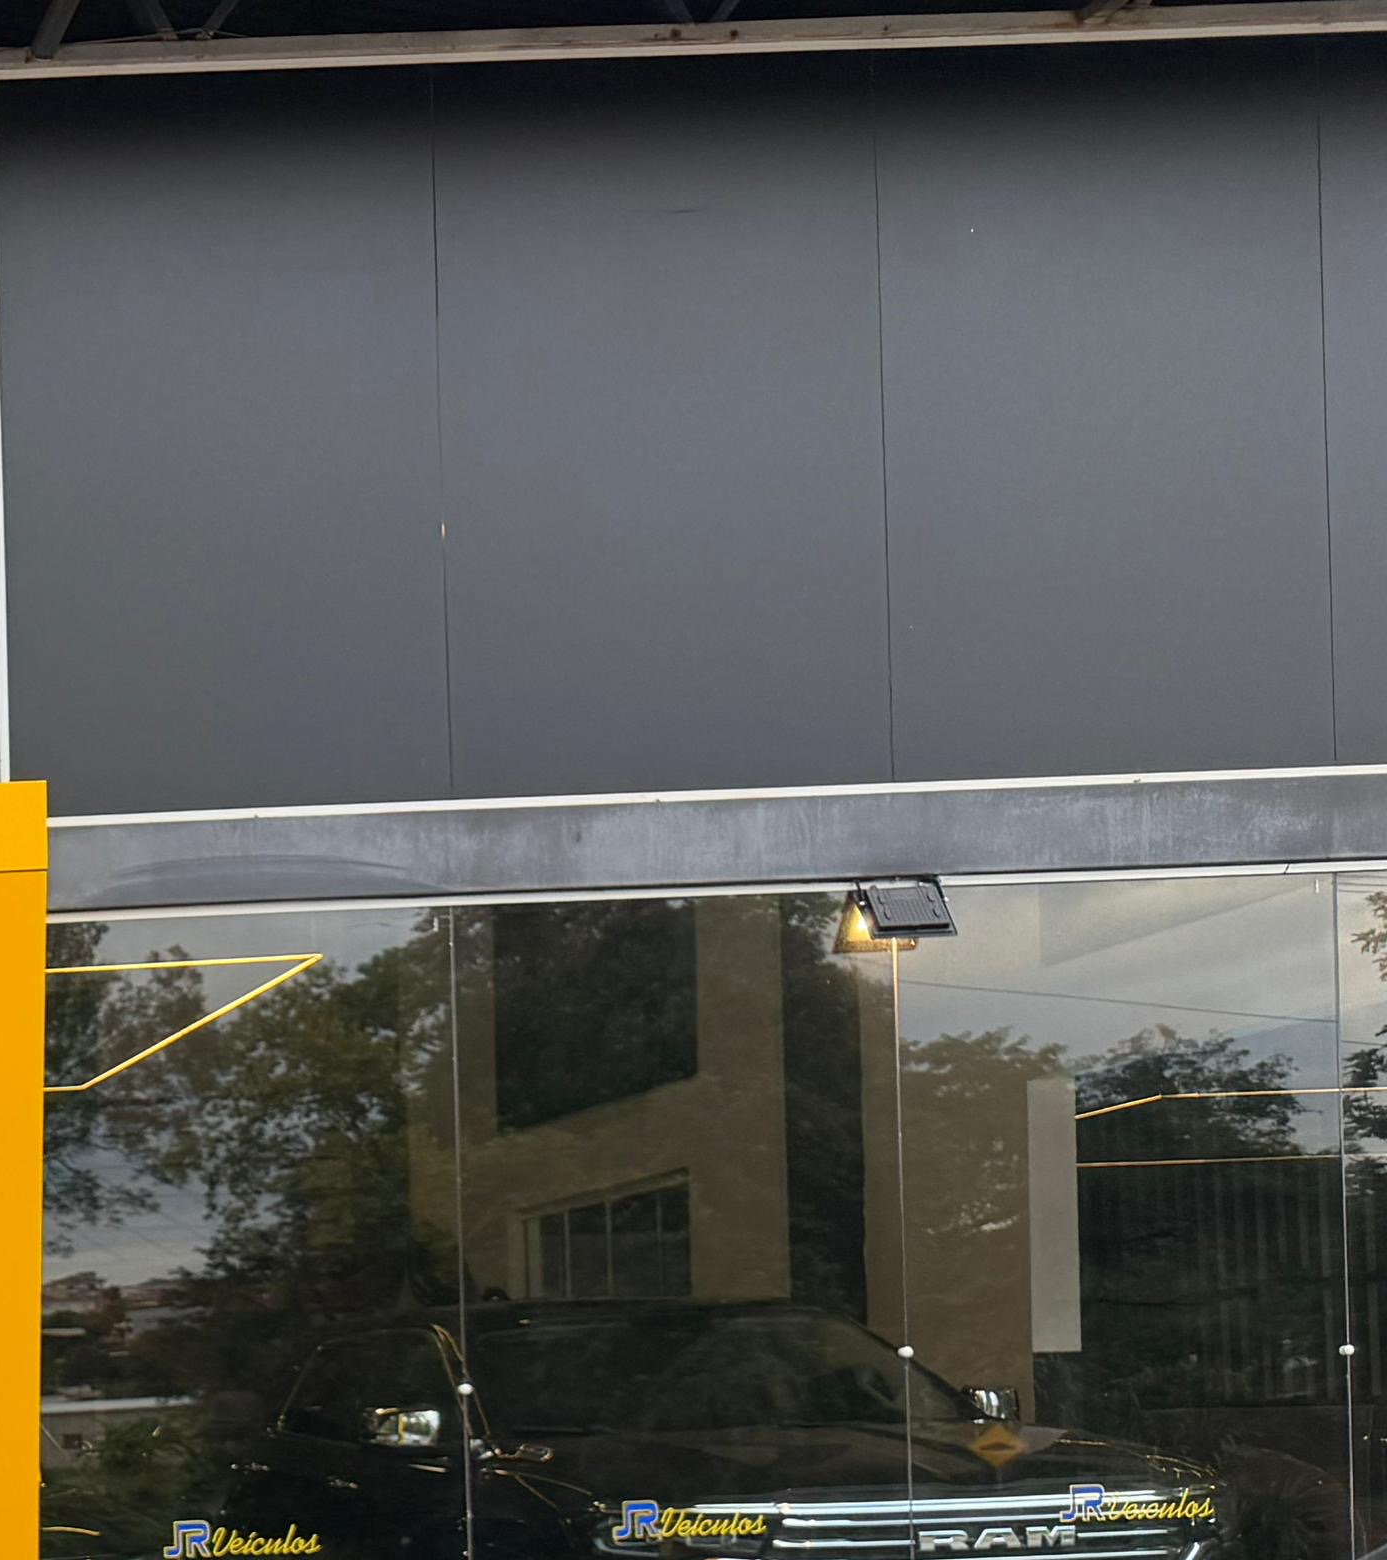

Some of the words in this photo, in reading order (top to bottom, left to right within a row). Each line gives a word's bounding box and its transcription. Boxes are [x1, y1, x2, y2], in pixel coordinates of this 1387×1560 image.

[612, 1500, 661, 1541] JR
[1059, 1484, 1105, 1522] JR
[163, 1519, 212, 1559] JR
[918, 1525, 1076, 1551] RAM
